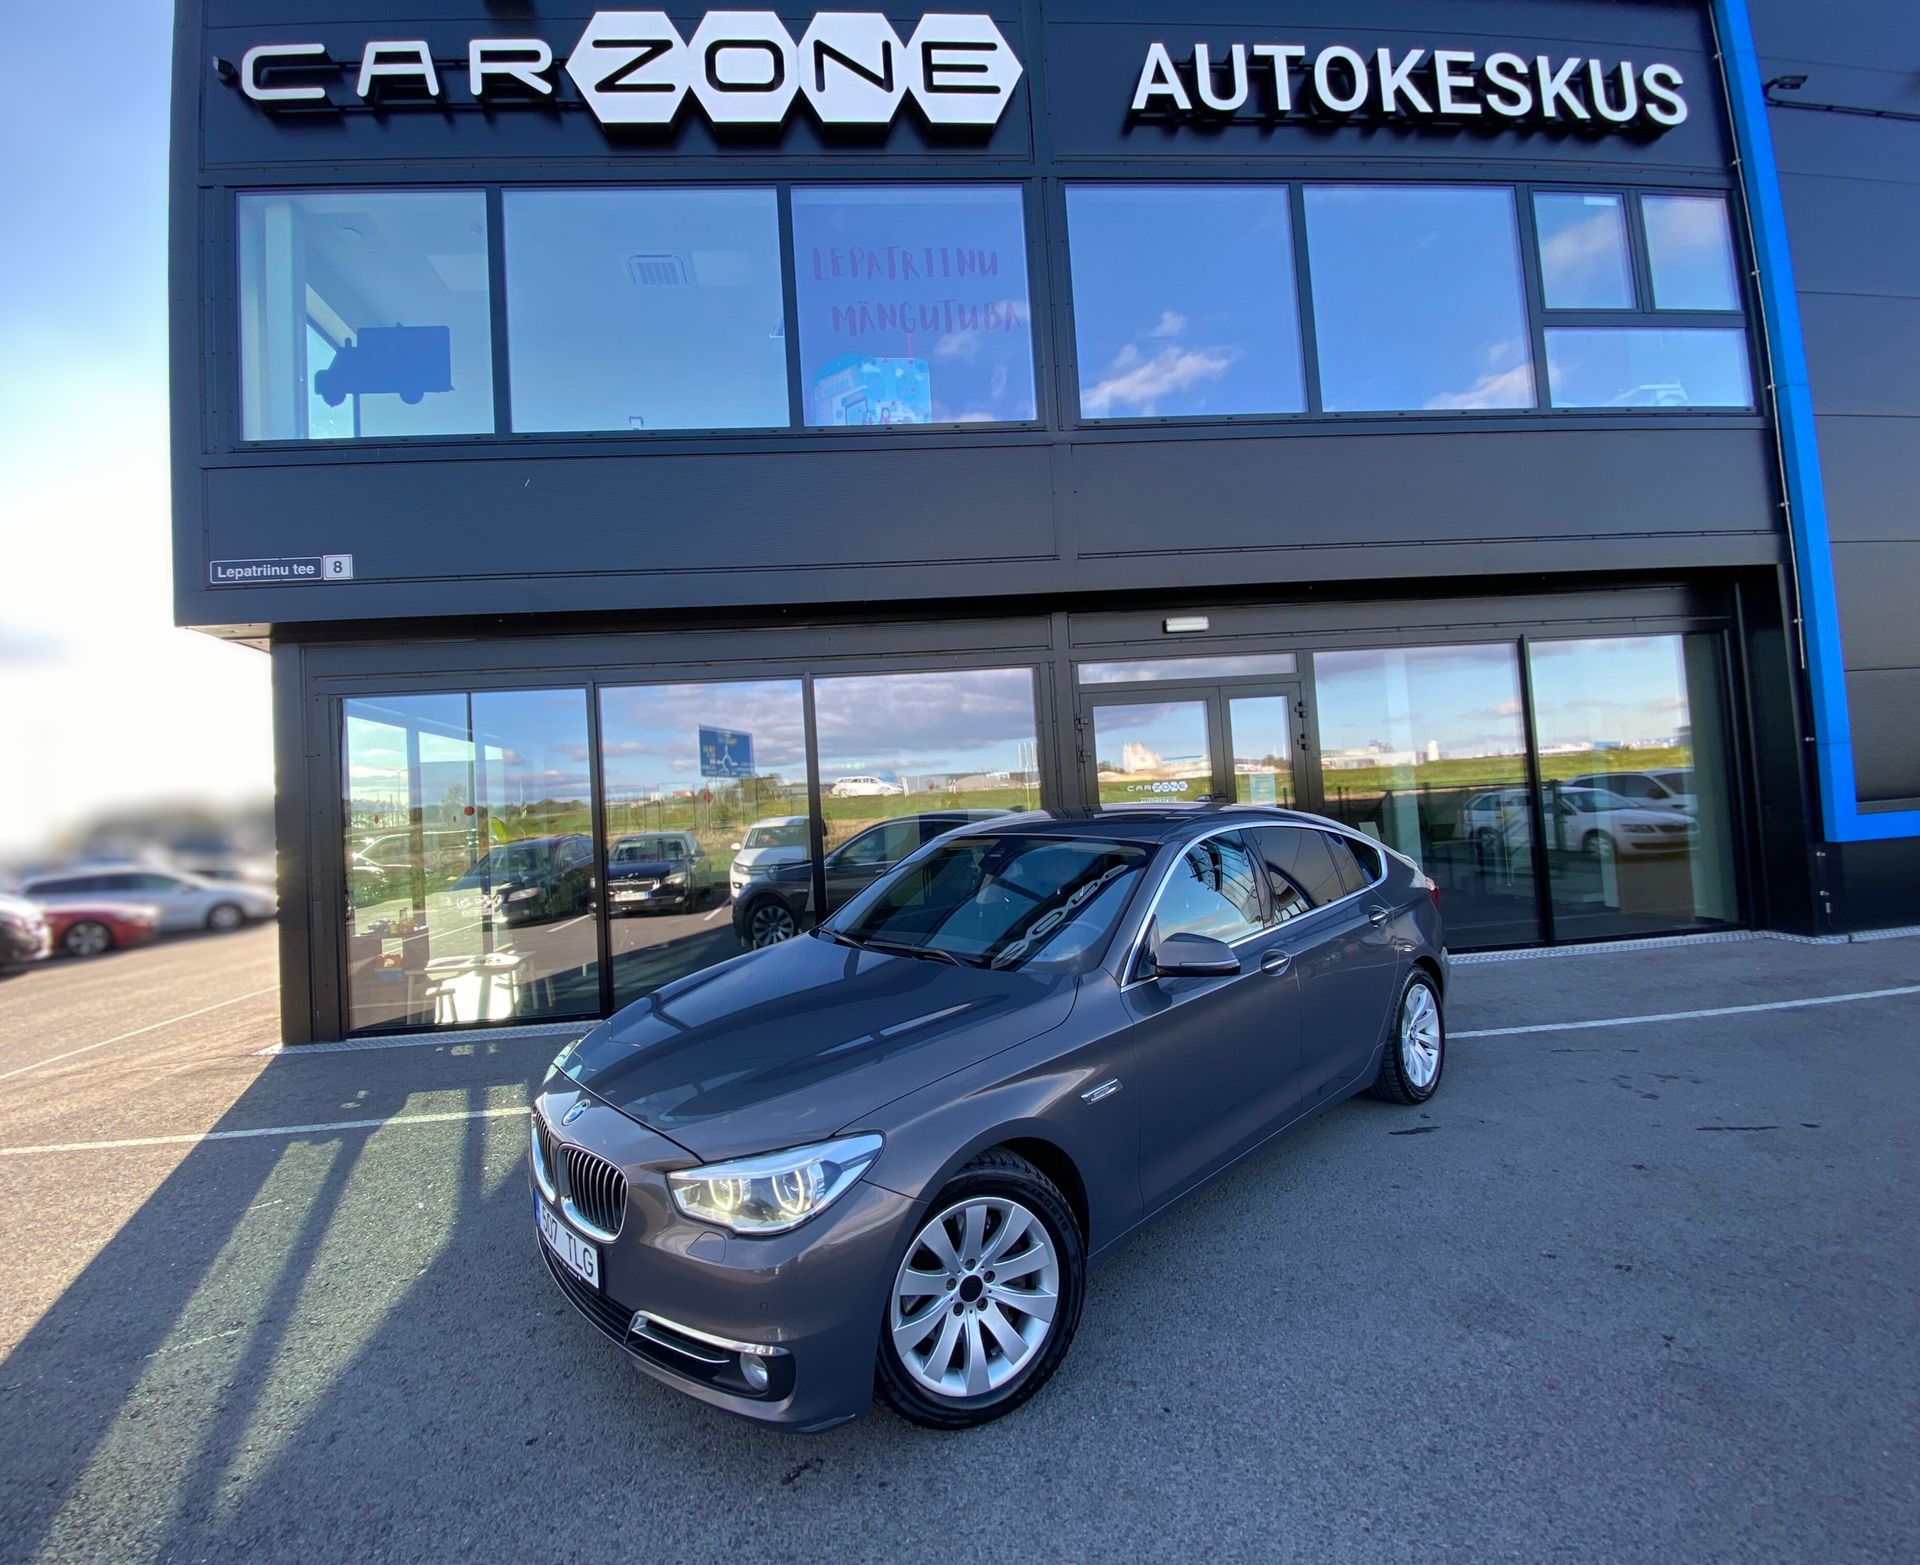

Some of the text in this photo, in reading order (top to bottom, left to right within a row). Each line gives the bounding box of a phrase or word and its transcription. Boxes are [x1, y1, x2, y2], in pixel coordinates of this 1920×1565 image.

[1131, 43, 1689, 126] AUTOKESKUS
[812, 246, 999, 281] LEPATRIINU
[831, 299, 1022, 336] MÄNGUTUBA
[217, 560, 343, 579] Lepatriinu tee 8
[566, 1232, 594, 1277] TLG
